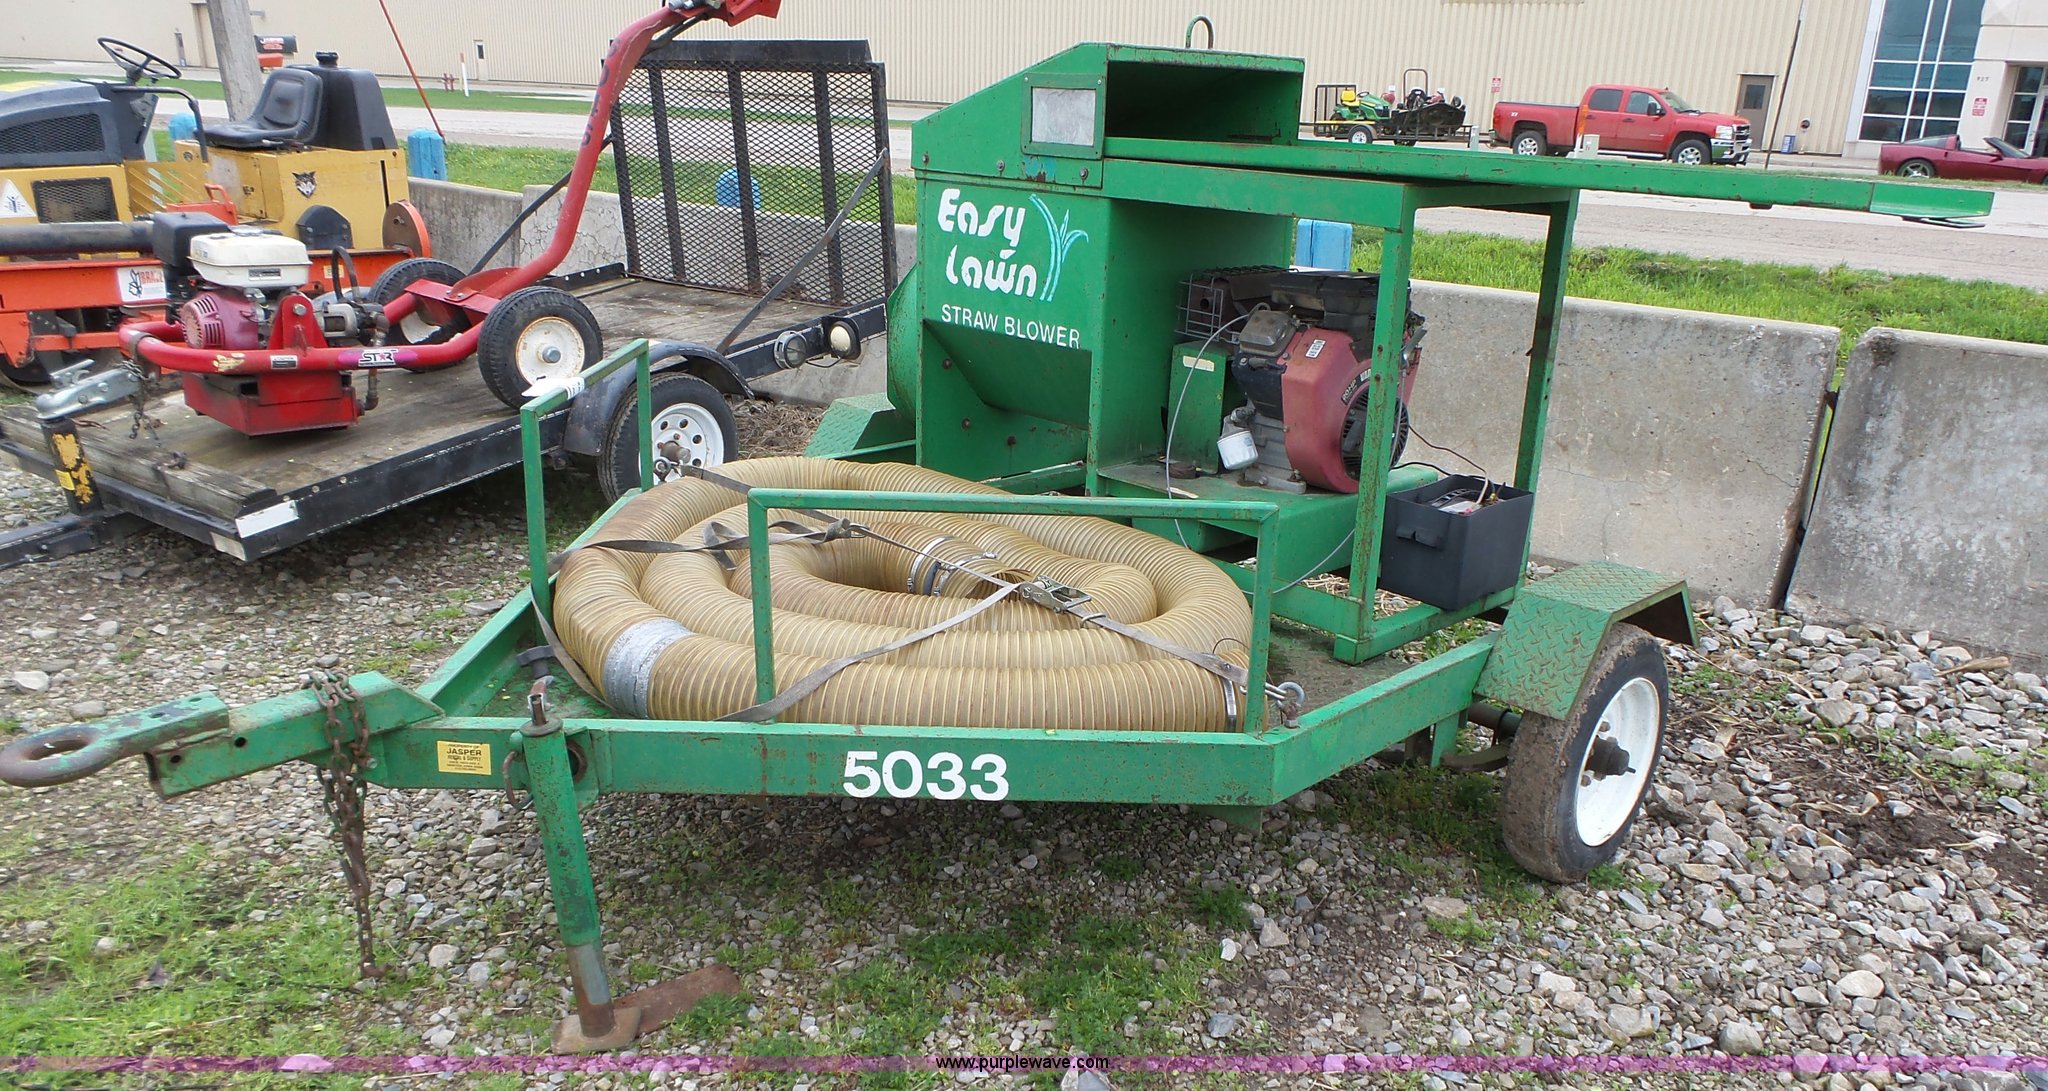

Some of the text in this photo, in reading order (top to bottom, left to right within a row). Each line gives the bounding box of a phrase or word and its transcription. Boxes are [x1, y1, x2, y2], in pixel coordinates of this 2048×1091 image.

[937, 188, 1026, 247] Easy
[941, 303, 1080, 349] STRAW BLOWER
[447, 748, 482, 756] JASPER
[843, 750, 1009, 801] 5033
